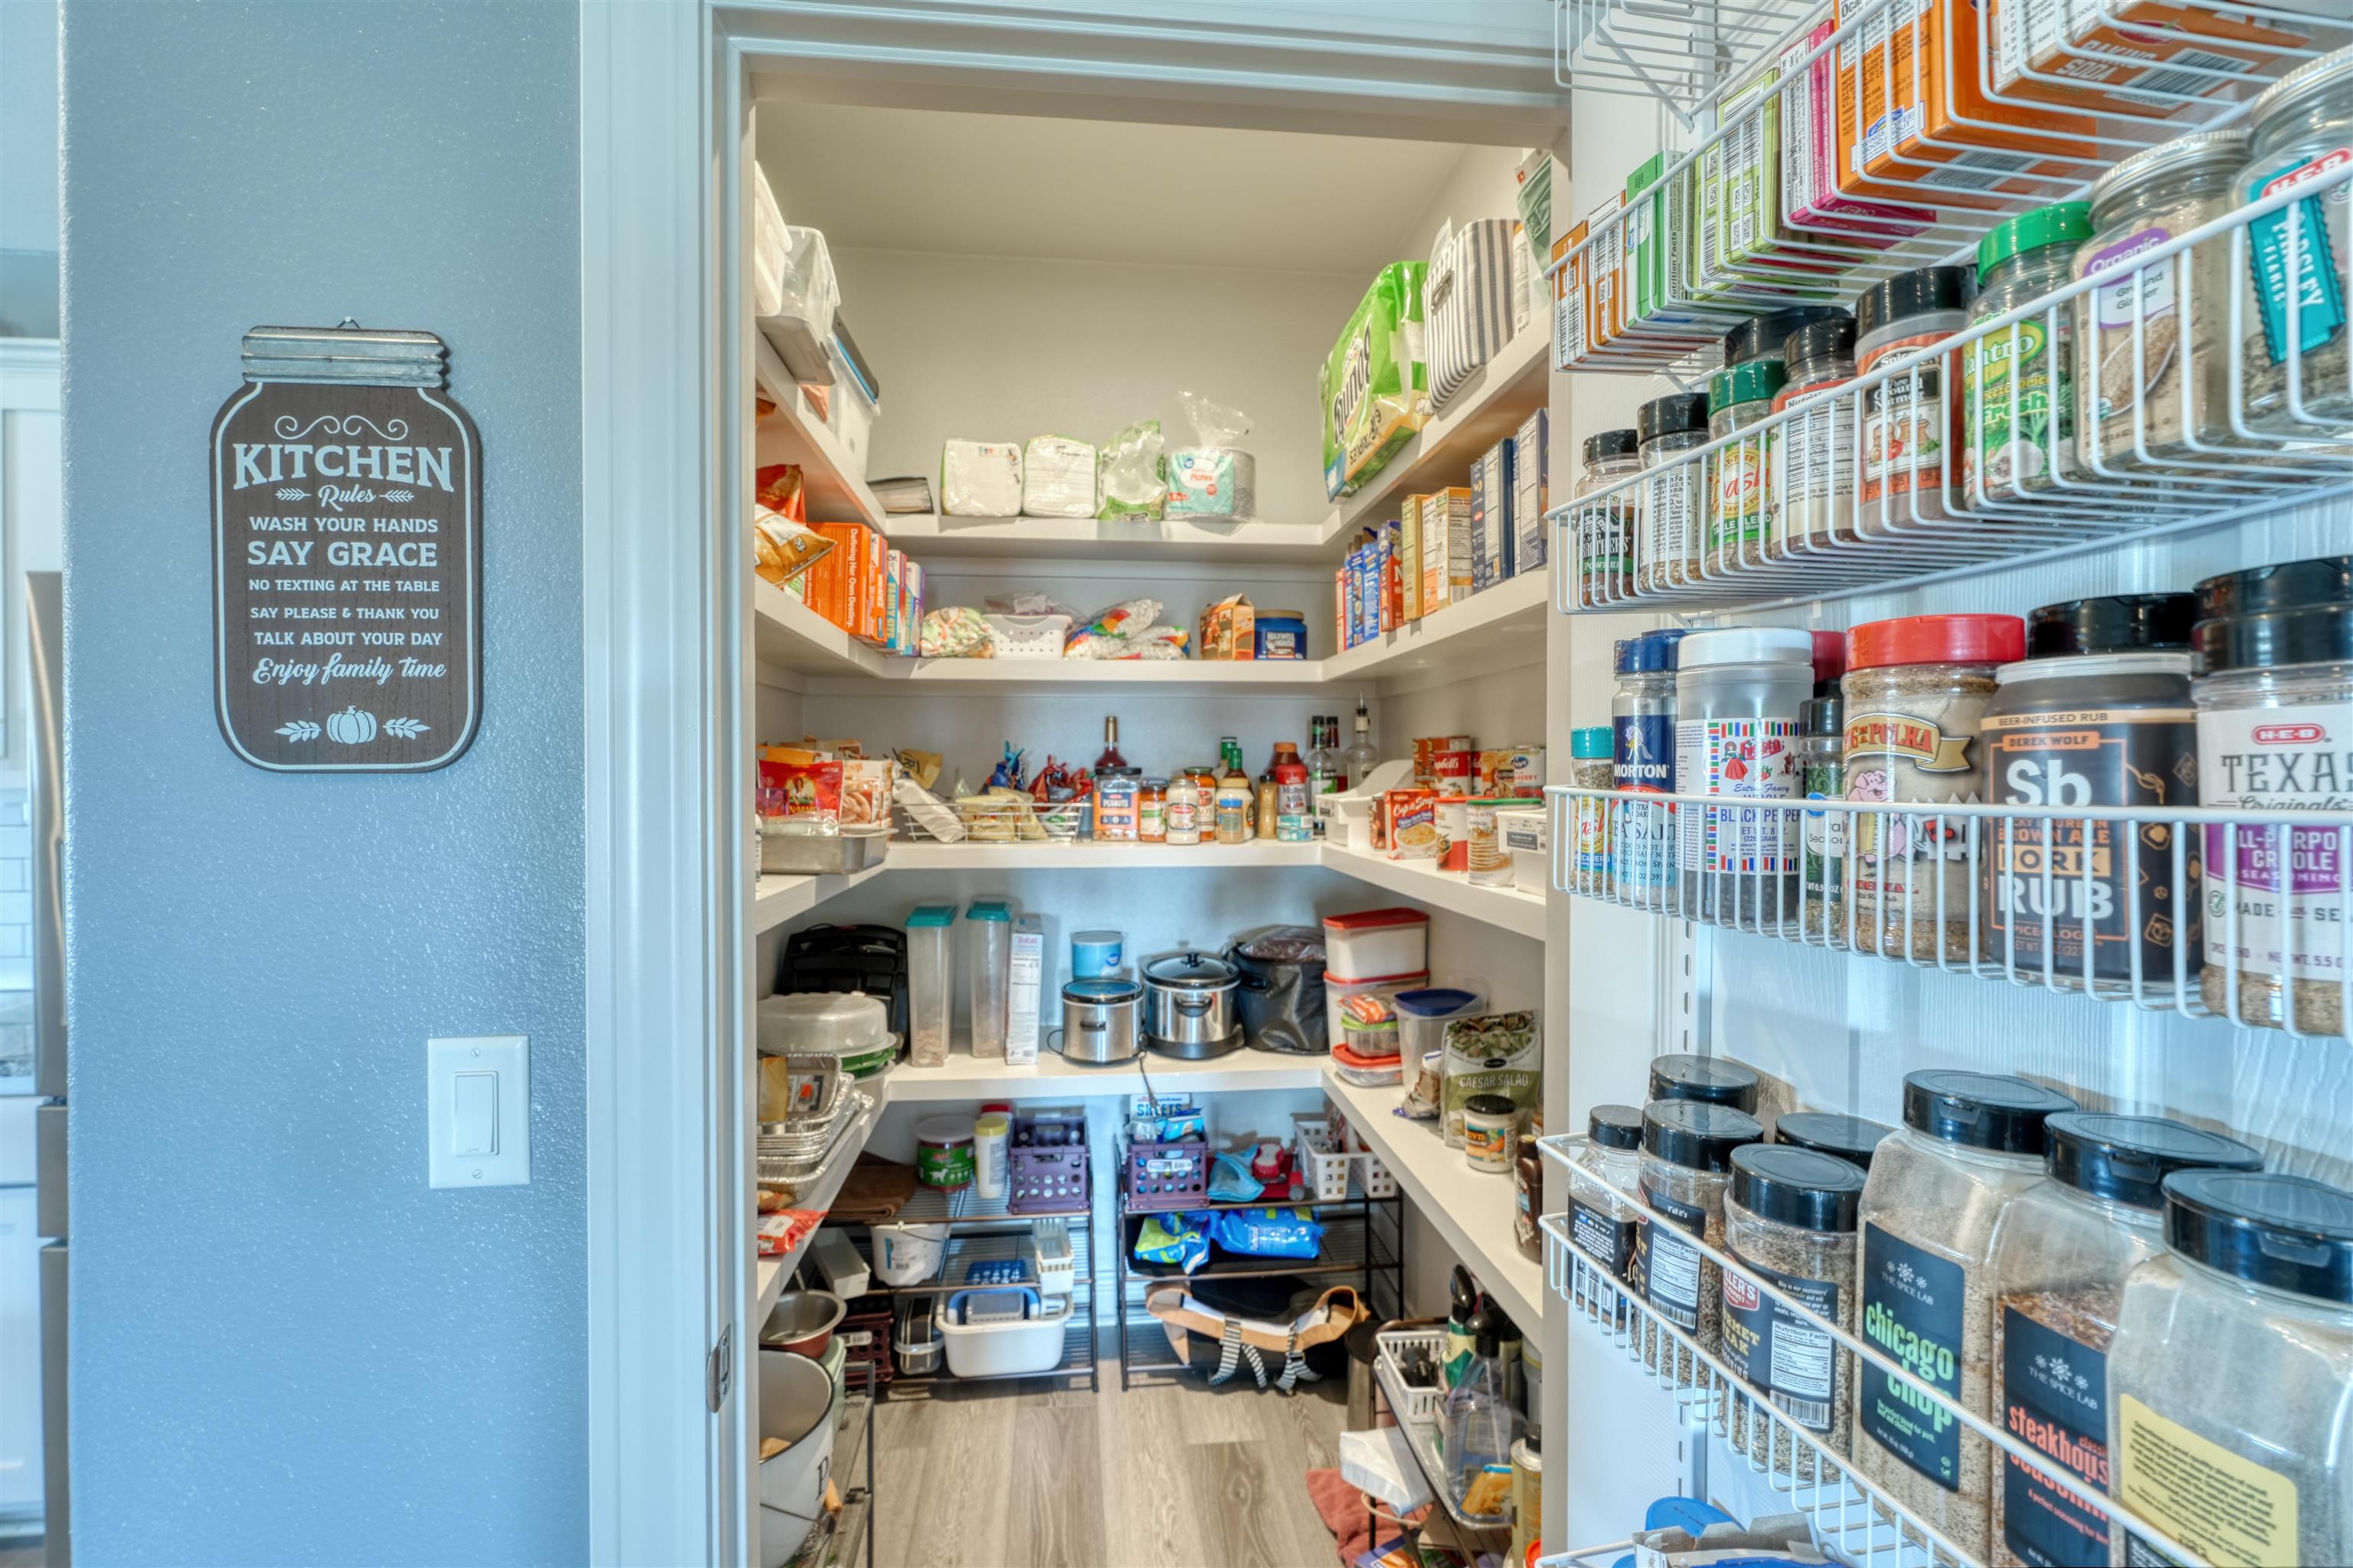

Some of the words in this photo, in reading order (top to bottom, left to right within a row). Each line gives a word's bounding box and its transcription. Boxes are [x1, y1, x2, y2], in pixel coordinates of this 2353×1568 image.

[2055, 59, 2119, 81] SODA
[2091, 237, 2160, 273] Organic
[2116, 271, 2164, 297] Grund
[2116, 287, 2158, 309] Giner
[1874, 378, 1924, 401] Gound
[233, 442, 454, 493] KITCHEN
[1190, 473, 1214, 482] Plates
[319, 484, 376, 512] Rules
[249, 516, 307, 532] WASH
[314, 517, 365, 532] YOUR
[373, 519, 438, 533] HANDS
[247, 541, 314, 565] SAY
[327, 542, 437, 566] GRACE
[849, 529, 858, 561] Defining
[849, 561, 857, 577] Her
[249, 579, 270, 591] NO
[275, 579, 335, 591] TEXTING
[340, 579, 358, 591] AT
[364, 579, 390, 592] THE
[395, 579, 440, 592] TABLE
[848, 577, 856, 596] Own
[250, 607, 277, 619] SAY
[284, 607, 337, 619] PLEASE
[342, 607, 352, 618] &
[356, 607, 404, 619] THANK
[411, 607, 439, 620] YOU
[846, 597, 856, 628] Destiny.
[254, 632, 294, 645] TALK
[301, 632, 355, 645] ABOUT
[362, 632, 404, 646] YOUR
[411, 632, 443, 646] DAY
[1266, 631, 1294, 640] MAXWELL
[253, 657, 319, 685] Enjoy
[321, 652, 393, 684] family
[399, 656, 447, 678] time
[1998, 713, 2076, 726] BEER-INFUSED
[2080, 712, 2109, 723] RUB
[1868, 722, 1933, 754] POLKA
[2009, 735, 2047, 748] DEREK
[2050, 735, 2090, 745] WOLF
[1434, 757, 1459, 769] mpbell's
[1614, 764, 1667, 777] MORTON
[1764, 784, 1790, 793] Fancy
[2005, 759, 2093, 807] Sb
[1998, 828, 2062, 843] BOWN
[2252, 849, 2334, 871] CROLE
[2241, 869, 2342, 882] SEASNING
[1998, 875, 2114, 920] RUB
[1016, 936, 1039, 944] Total
[2014, 925, 2097, 940] PICELOG
[1459, 1075, 1495, 1089] CAESAR
[1498, 1074, 1529, 1087] SALAD
[1654, 1234, 1679, 1249] Nutrition
[1916, 1288, 1934, 1306] LAB
[1775, 1324, 1808, 1337] Nutrition
[1809, 1332, 1829, 1340] Facts
[1865, 1301, 1954, 1382] chicago
[2076, 1386, 2098, 1410] LAB
[2008, 1404, 2108, 1487] steakhous
[2078, 1434, 2107, 1456] classi
